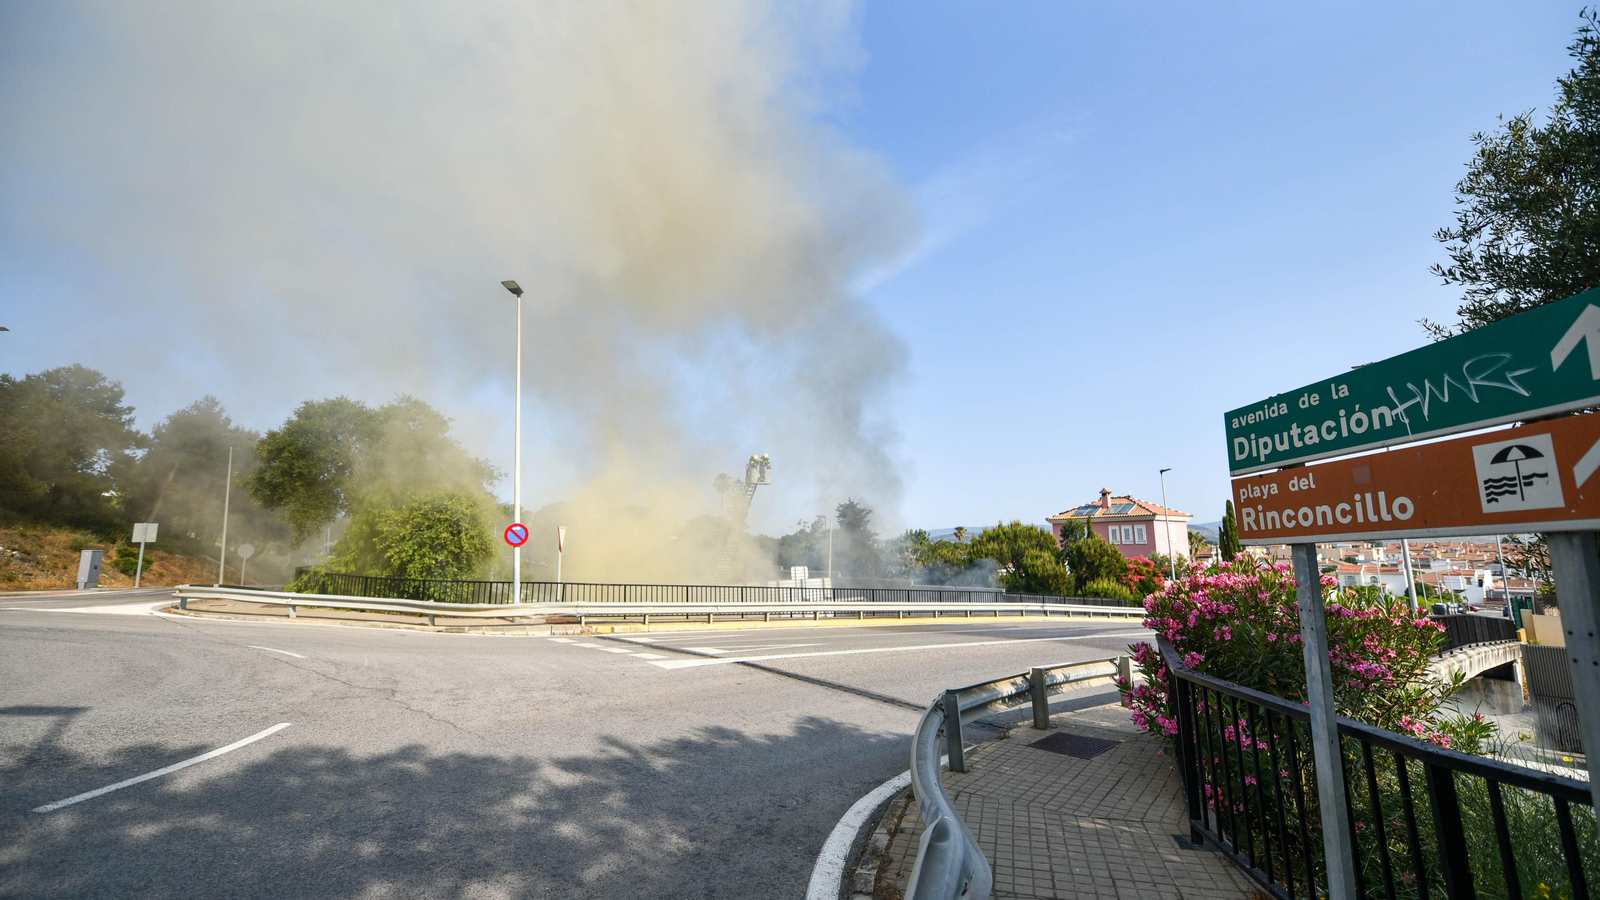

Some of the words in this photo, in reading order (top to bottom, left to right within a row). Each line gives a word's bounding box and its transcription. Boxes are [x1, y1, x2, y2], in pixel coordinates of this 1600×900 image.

[1231, 402, 1288, 429] avenida
[1298, 393, 1320, 409] de
[1330, 383, 1350, 400] la
[1233, 404, 1394, 462] Diputación
[1239, 483, 1279, 503] playa
[1288, 472, 1316, 492] del
[1241, 491, 1415, 532] Rinconcillo
